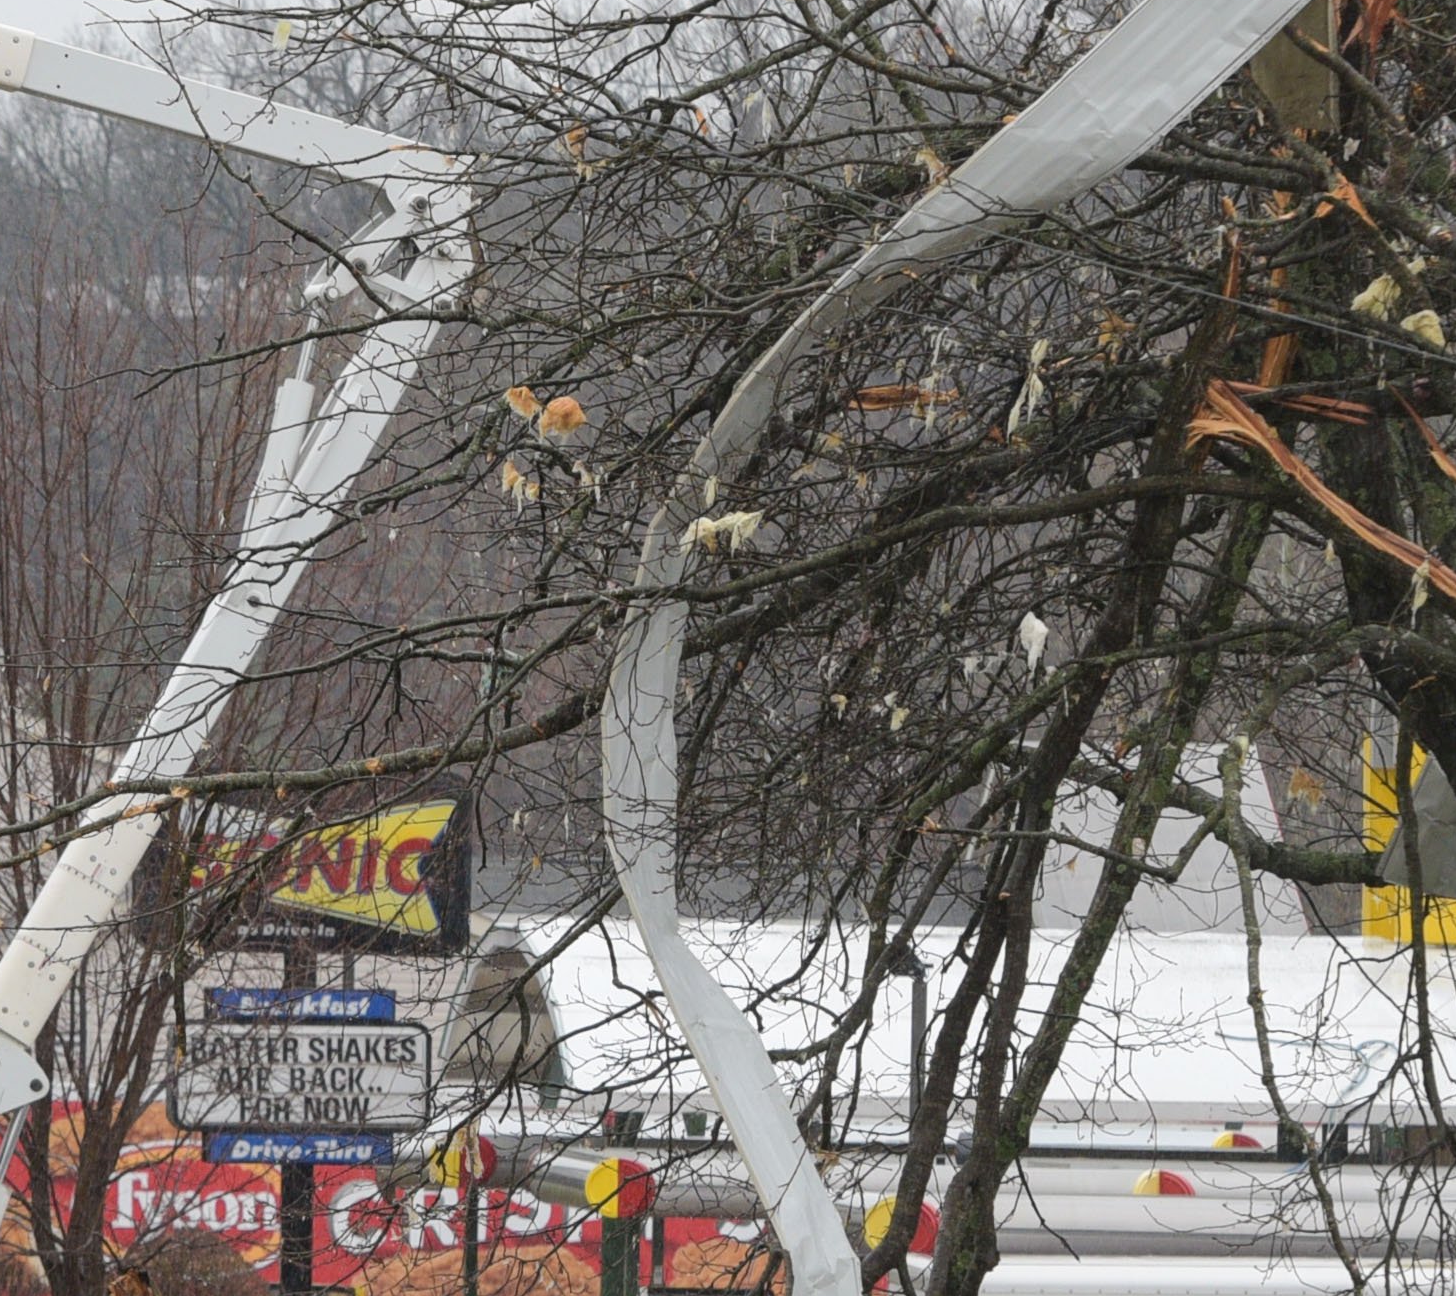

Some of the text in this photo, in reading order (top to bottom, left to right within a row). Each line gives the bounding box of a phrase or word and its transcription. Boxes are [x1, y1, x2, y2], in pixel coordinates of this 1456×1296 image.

[192, 1037, 417, 1063] BATTER SHAKES
[217, 1067, 271, 1093] ARE
[241, 1096, 371, 1122] FOR NOW
[109, 1171, 281, 1243] Tyson
